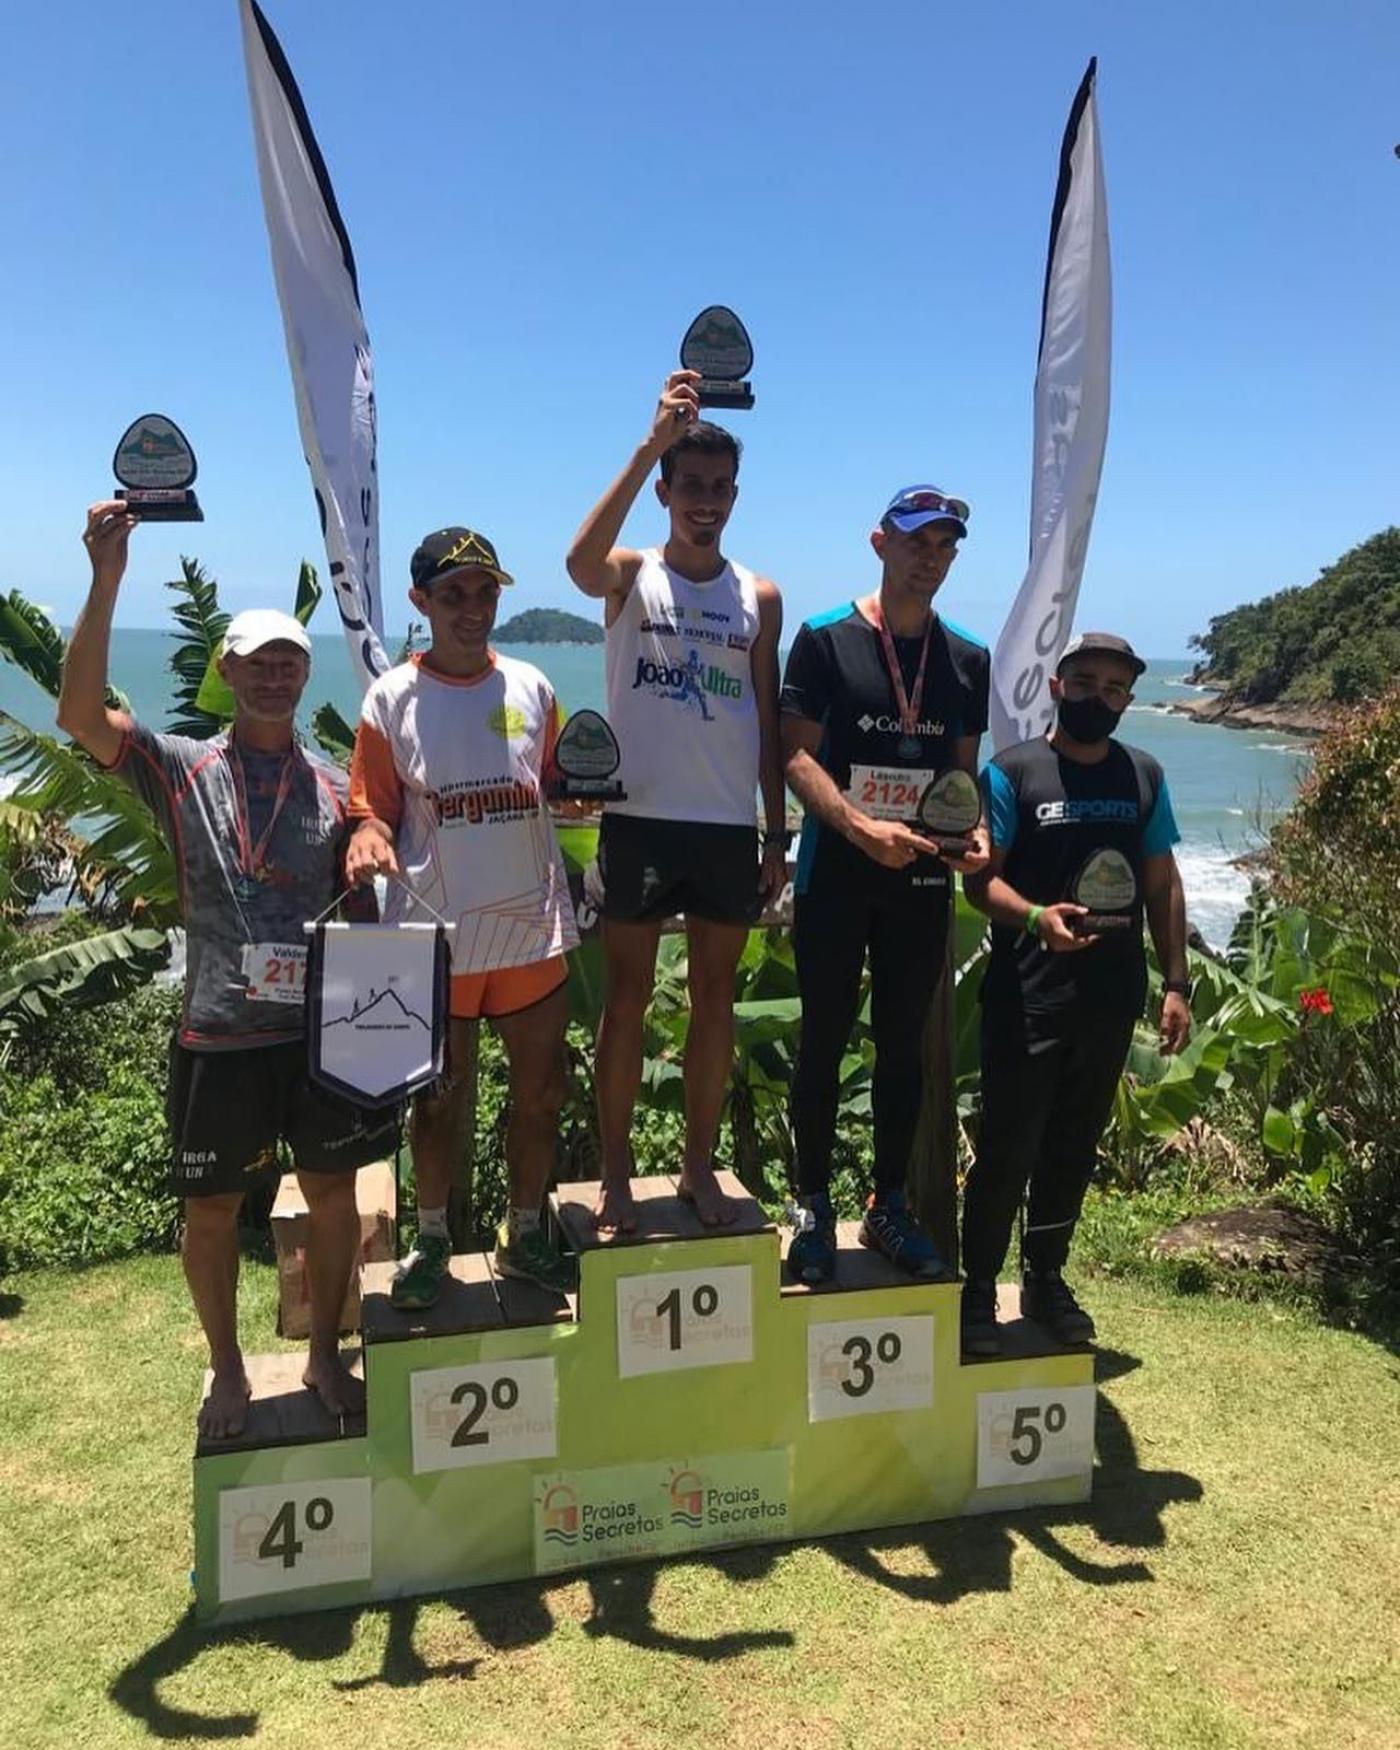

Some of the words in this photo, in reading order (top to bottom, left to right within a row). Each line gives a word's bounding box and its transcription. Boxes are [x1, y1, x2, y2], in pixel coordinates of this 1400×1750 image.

[700, 665, 741, 699] Ultra
[875, 714, 945, 736] Colmbia
[861, 780, 919, 806] 2124
[656, 1284, 719, 1351] 1º
[841, 1331, 902, 1398] 3º
[451, 1376, 519, 1448] 2º
[1010, 1402, 1067, 1467] 5º
[706, 1487, 760, 1507] Praias
[581, 1502, 636, 1523] Praias
[707, 1501, 788, 1526] Secretas
[258, 1496, 334, 1569] 4º
[581, 1516, 665, 1543] Secretas
